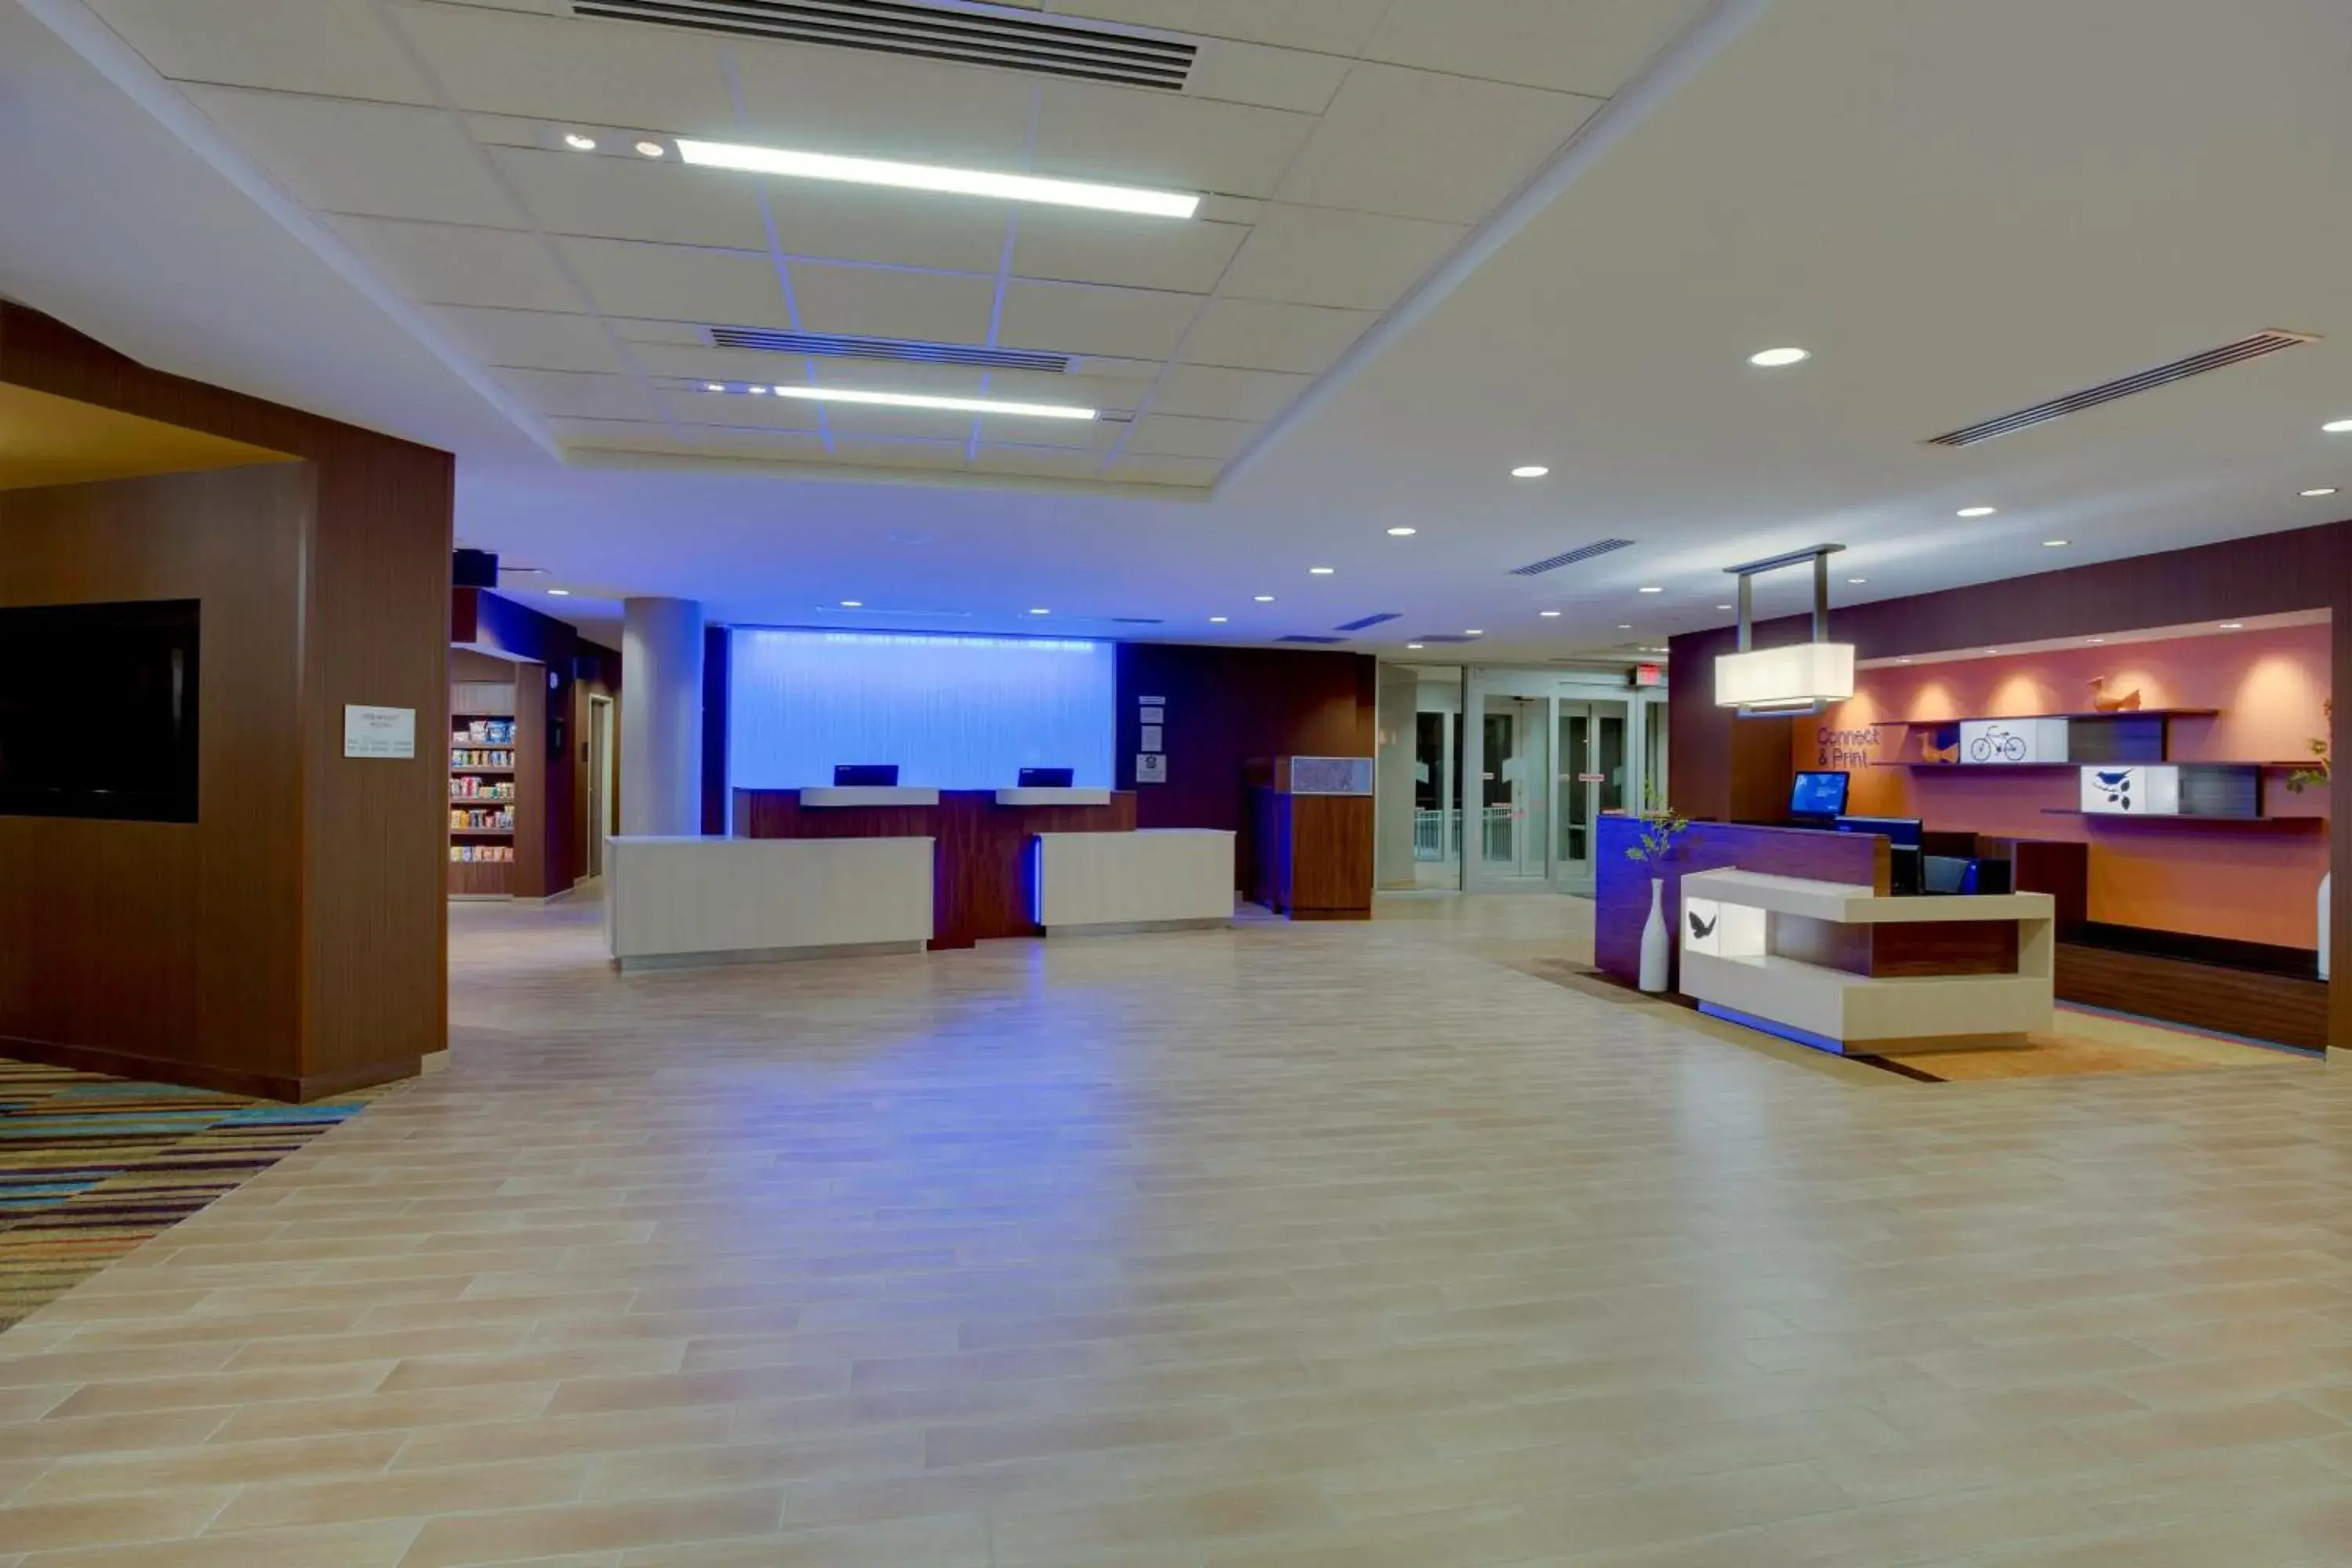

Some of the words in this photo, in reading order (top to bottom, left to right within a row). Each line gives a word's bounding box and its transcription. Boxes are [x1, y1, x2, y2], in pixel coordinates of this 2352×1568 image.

[1818, 727, 1879, 745] Connect
[1818, 747, 1828, 766] &
[1832, 747, 1867, 768] Print
